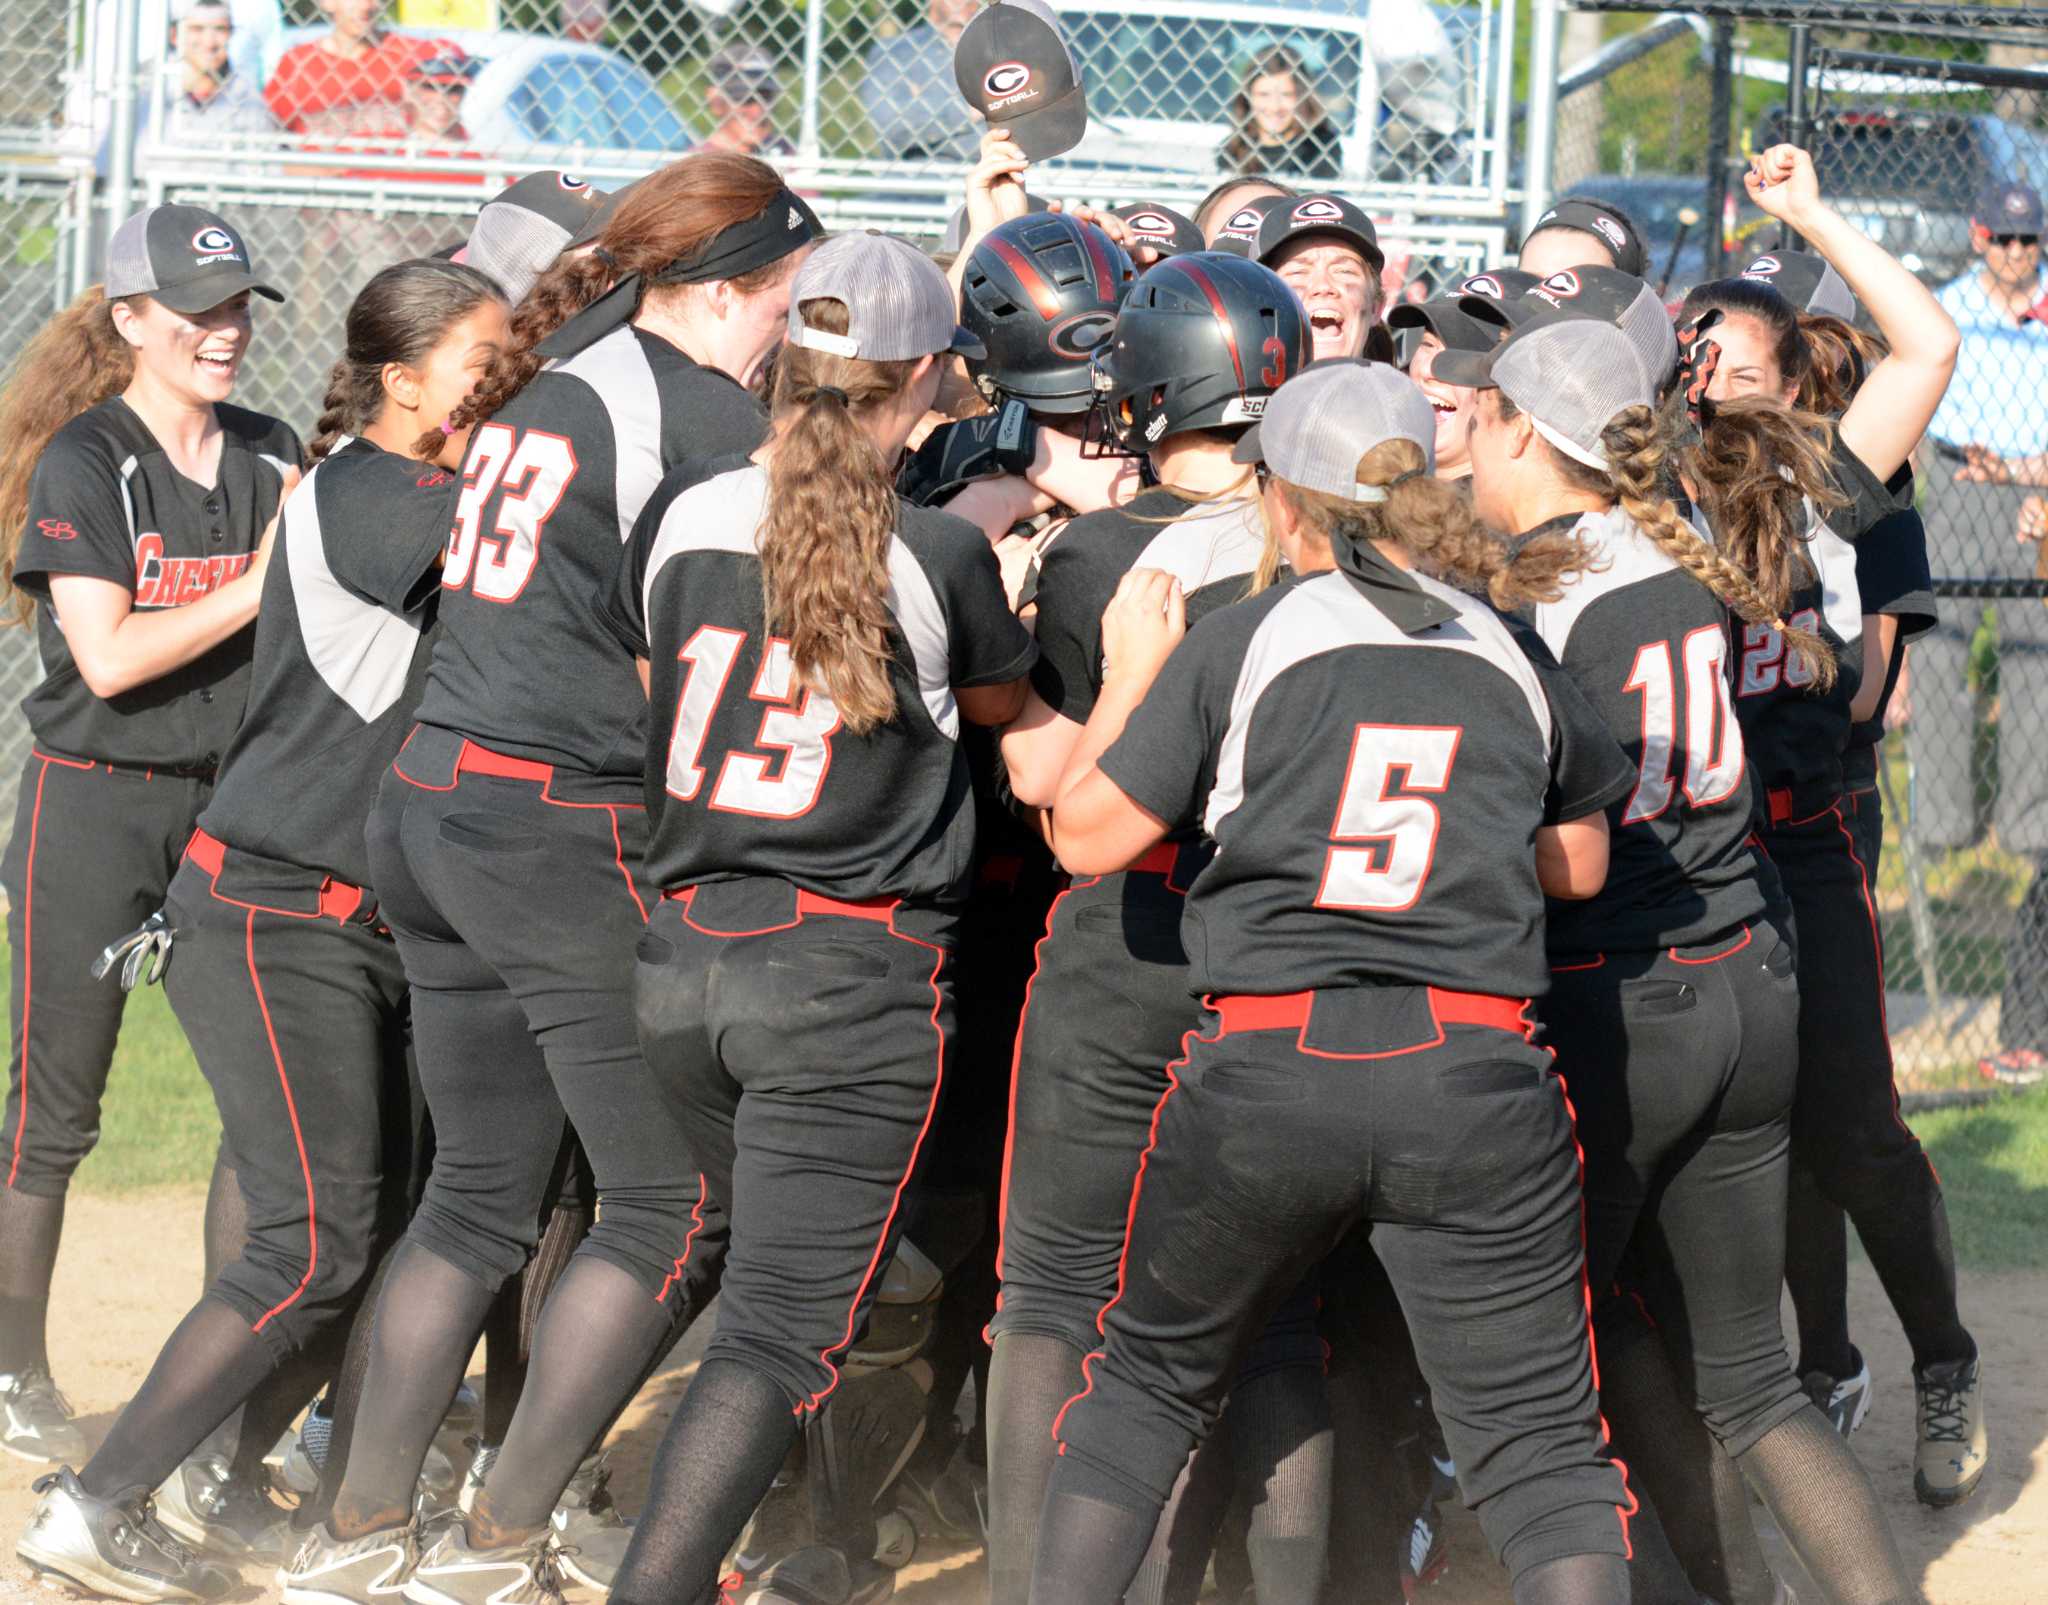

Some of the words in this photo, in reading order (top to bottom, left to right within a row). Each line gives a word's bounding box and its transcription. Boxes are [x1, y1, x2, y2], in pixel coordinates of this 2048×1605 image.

[988, 89, 1039, 110] SOFTBALL
[196, 253, 242, 266] SOFTBALL
[1262, 336, 1286, 388] 3
[441, 421, 580, 604] 33
[665, 623, 842, 821] 13
[1621, 622, 1745, 827] 10
[1312, 722, 1464, 912] 5
